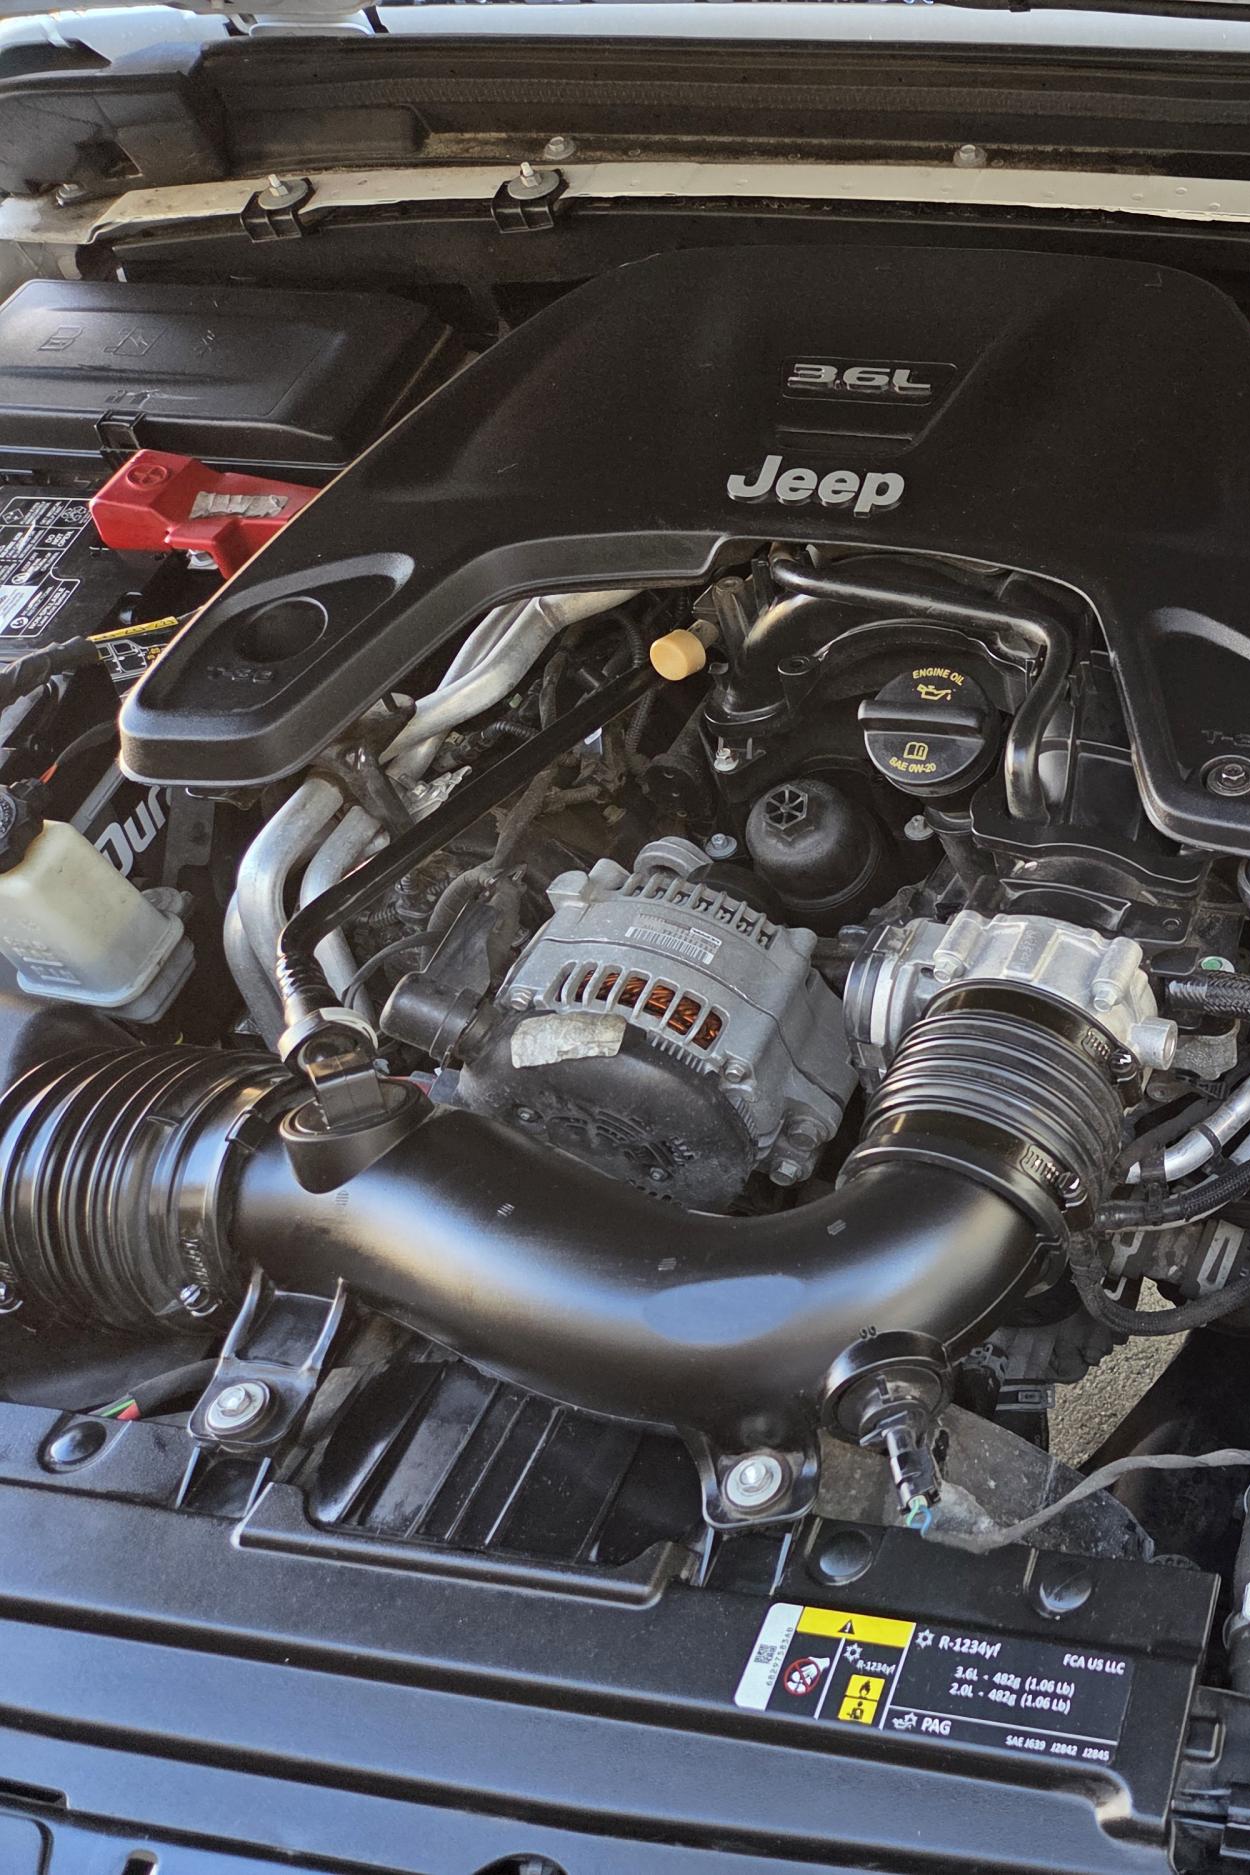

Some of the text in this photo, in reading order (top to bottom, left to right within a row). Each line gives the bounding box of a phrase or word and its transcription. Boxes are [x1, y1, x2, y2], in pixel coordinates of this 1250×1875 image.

[787, 363, 931, 393] 3.6L
[727, 455, 905, 517] Jeep
[912, 667, 965, 686] ENGINE OIL
[889, 756, 936, 774] SAE 0W-20
[938, 1635, 1001, 1660] R-1234yf
[856, 1658, 896, 1676] R-1234yf
[1063, 1653, 1126, 1675] FCA US LLC
[954, 1666, 978, 1682] 3.6L
[993, 1671, 1021, 1690] 482g
[1025, 1676, 1055, 1694] (1.06
[1056, 1681, 1075, 1699] Lb)
[949, 1683, 973, 1698] 2.0L
[988, 1688, 1016, 1707] 482g
[1020, 1693, 1050, 1710] (1.06
[1051, 1698, 1071, 1715] Lb)
[921, 1717, 951, 1736] PAG
[1005, 1735, 1024, 1748] SAE
